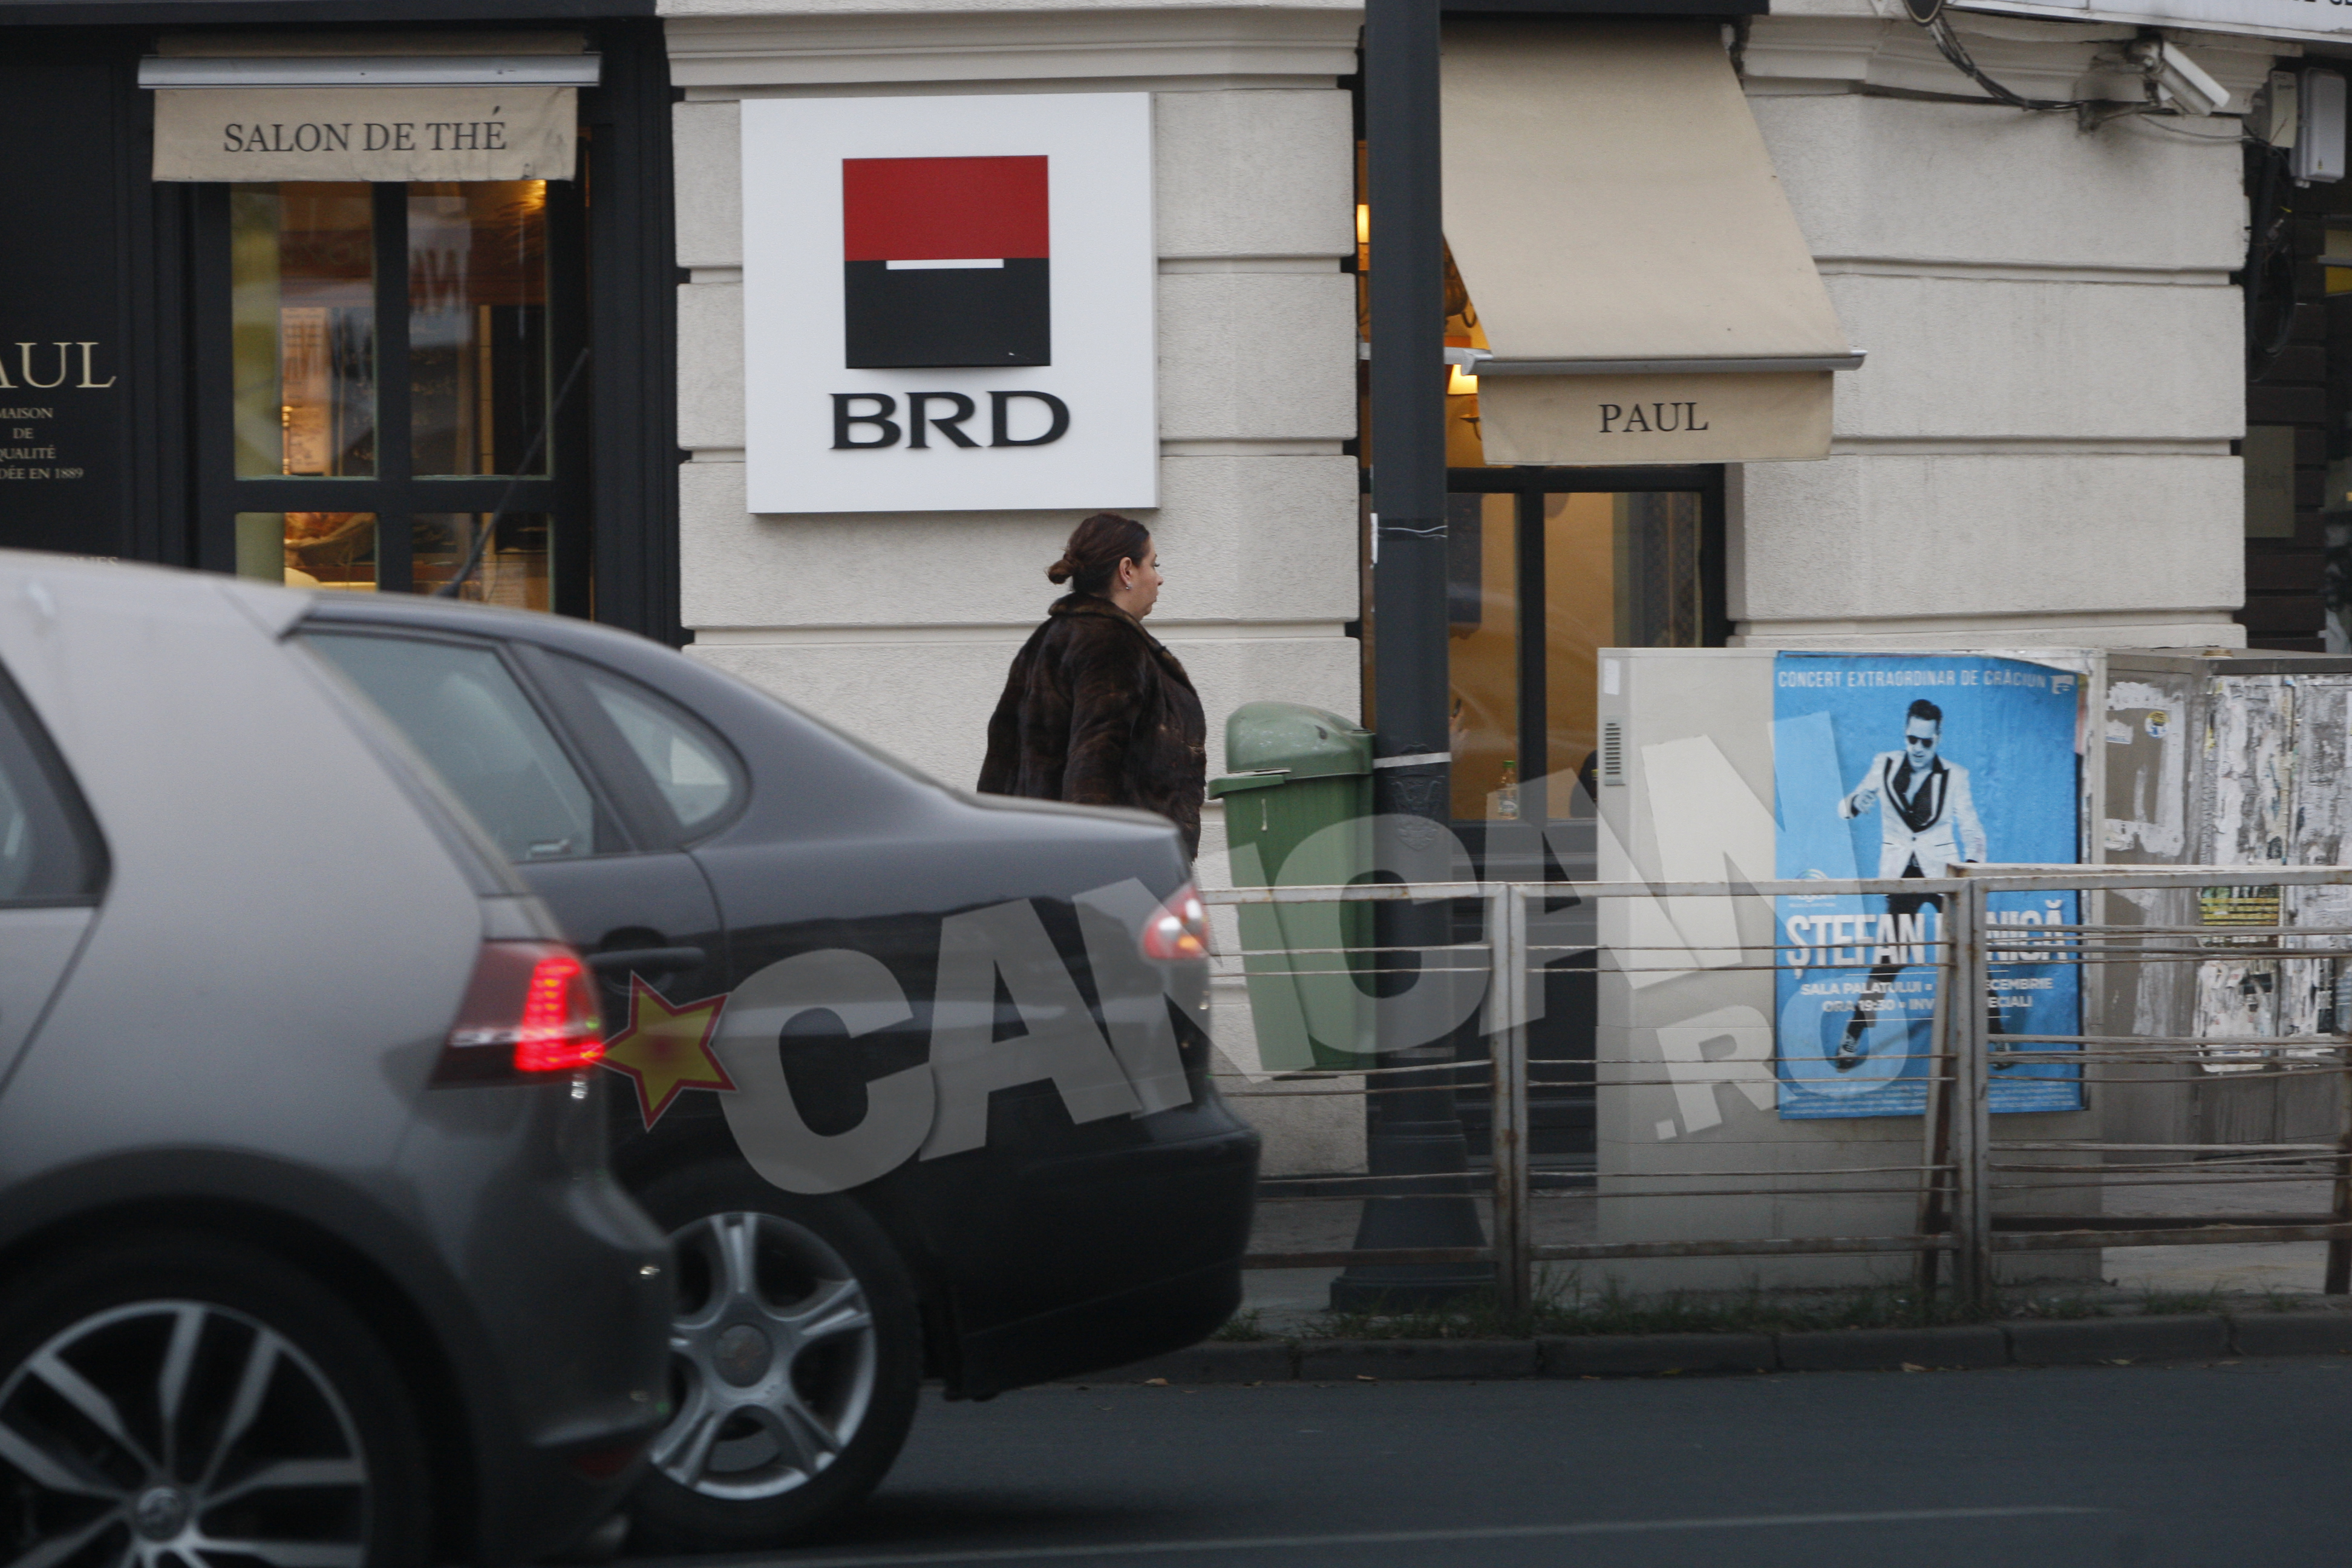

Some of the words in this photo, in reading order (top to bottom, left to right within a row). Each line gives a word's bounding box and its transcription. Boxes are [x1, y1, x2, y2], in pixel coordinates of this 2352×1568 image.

[224, 123, 353, 152] SALON
[363, 123, 416, 151] DE
[426, 105, 506, 151] THÉ
[828, 390, 1070, 450] BRD
[1598, 402, 1710, 433] PAUL
[13, 427, 34, 439] DE
[28, 468, 50, 479] EN
[54, 468, 84, 479] 1889
[1778, 671, 1843, 687] CONCERT
[1847, 670, 1956, 687] EXTRAORDINAR
[1960, 670, 1979, 686] DE
[1983, 668, 2047, 688] CRĂCIUN
[1786, 913, 1925, 980] ȘTEFAN
[1800, 983, 1840, 996] SALA
[1843, 981, 1922, 995] PALATULUI
[1822, 1000, 1855, 1013] ORA
[1857, 999, 1896, 1012] 19:30
